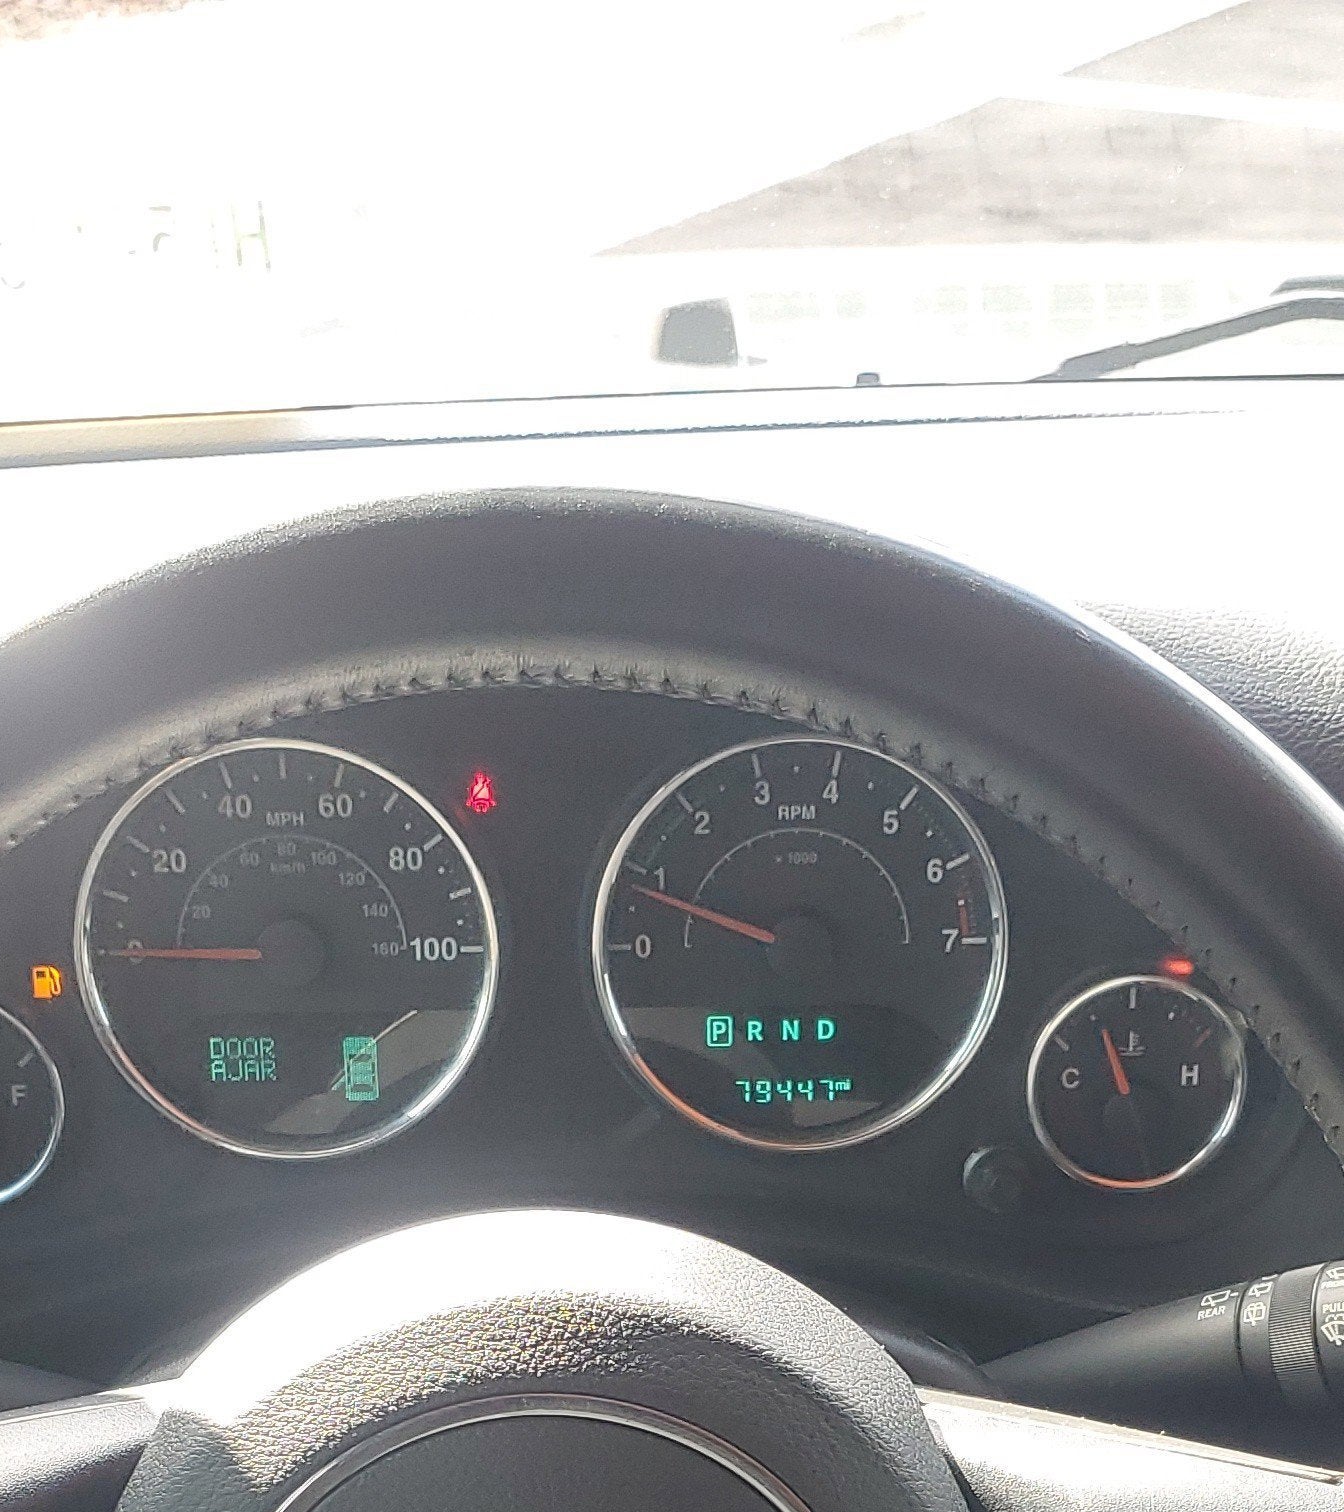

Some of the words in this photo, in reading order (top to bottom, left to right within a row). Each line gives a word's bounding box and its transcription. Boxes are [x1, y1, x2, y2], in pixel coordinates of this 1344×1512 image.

[755, 781, 770, 805] 3
[822, 780, 839, 804] 4
[219, 795, 252, 819] 40
[318, 795, 353, 819] 60
[777, 805, 816, 820] RPM
[266, 812, 304, 826] MPH
[694, 811, 711, 835] 2
[882, 810, 899, 834] 5
[153, 849, 187, 873] 20
[389, 848, 423, 871] 80
[927, 858, 944, 883] 6
[411, 938, 458, 961] 100
[635, 935, 651, 958] 0
[941, 929, 960, 953] 7
[747, 1021, 763, 1041] R
[782, 1019, 800, 1041] N
[818, 1019, 836, 1040] D
[210, 1037, 275, 1059] DOOR
[212, 1060, 277, 1081] AJAR
[1061, 1068, 1080, 1089] C
[1180, 1064, 1200, 1087] H
[11, 1085, 27, 1106] F
[1197, 1306, 1226, 1321] REAR
